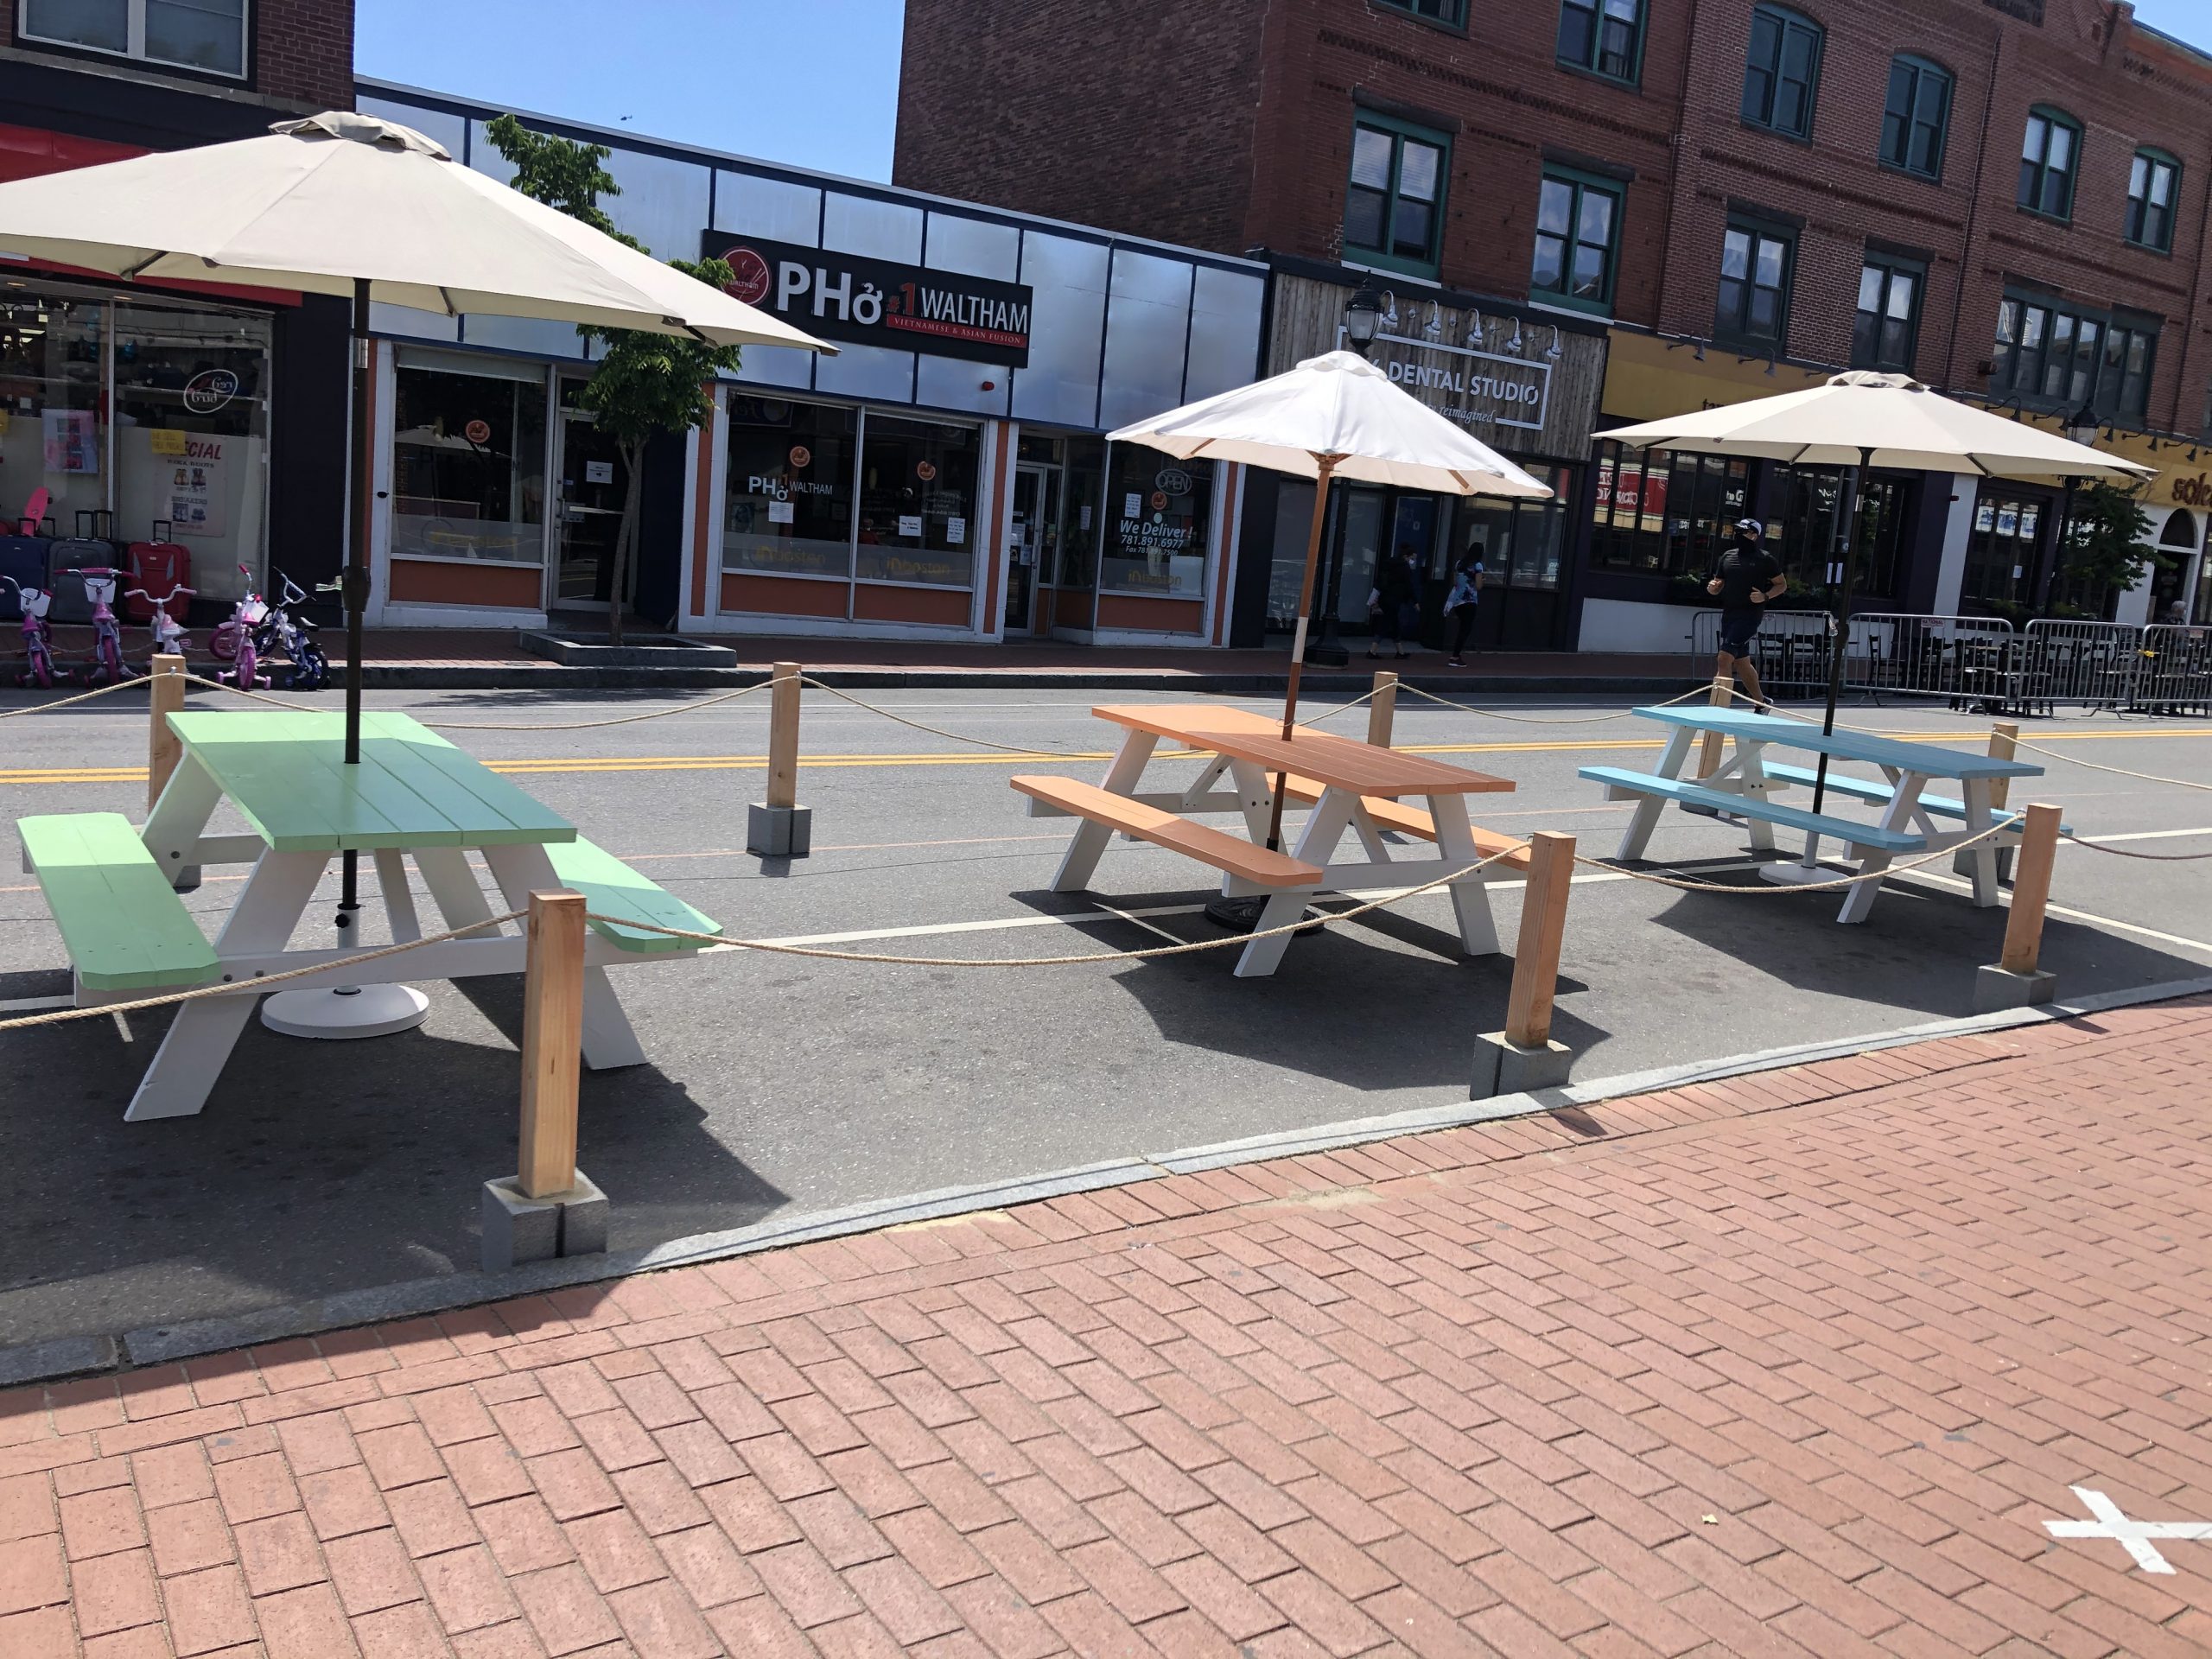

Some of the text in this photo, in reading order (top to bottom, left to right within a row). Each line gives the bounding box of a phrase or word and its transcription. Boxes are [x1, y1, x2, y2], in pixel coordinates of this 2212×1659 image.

[921, 287, 1028, 334] WALTHAM
[893, 317, 1021, 344] VIETNAMESE & ASIAN FUSION
[1388, 361, 1539, 405] DENTAL STUDIO
[1438, 404, 1496, 424] reimagined
[789, 480, 833, 495] WALTHAM
[1157, 474, 1189, 492] OPEN
[1120, 520, 1140, 535] We
[1141, 522, 1186, 537] Deliver
[1121, 534, 1184, 549] 781.891.6977
